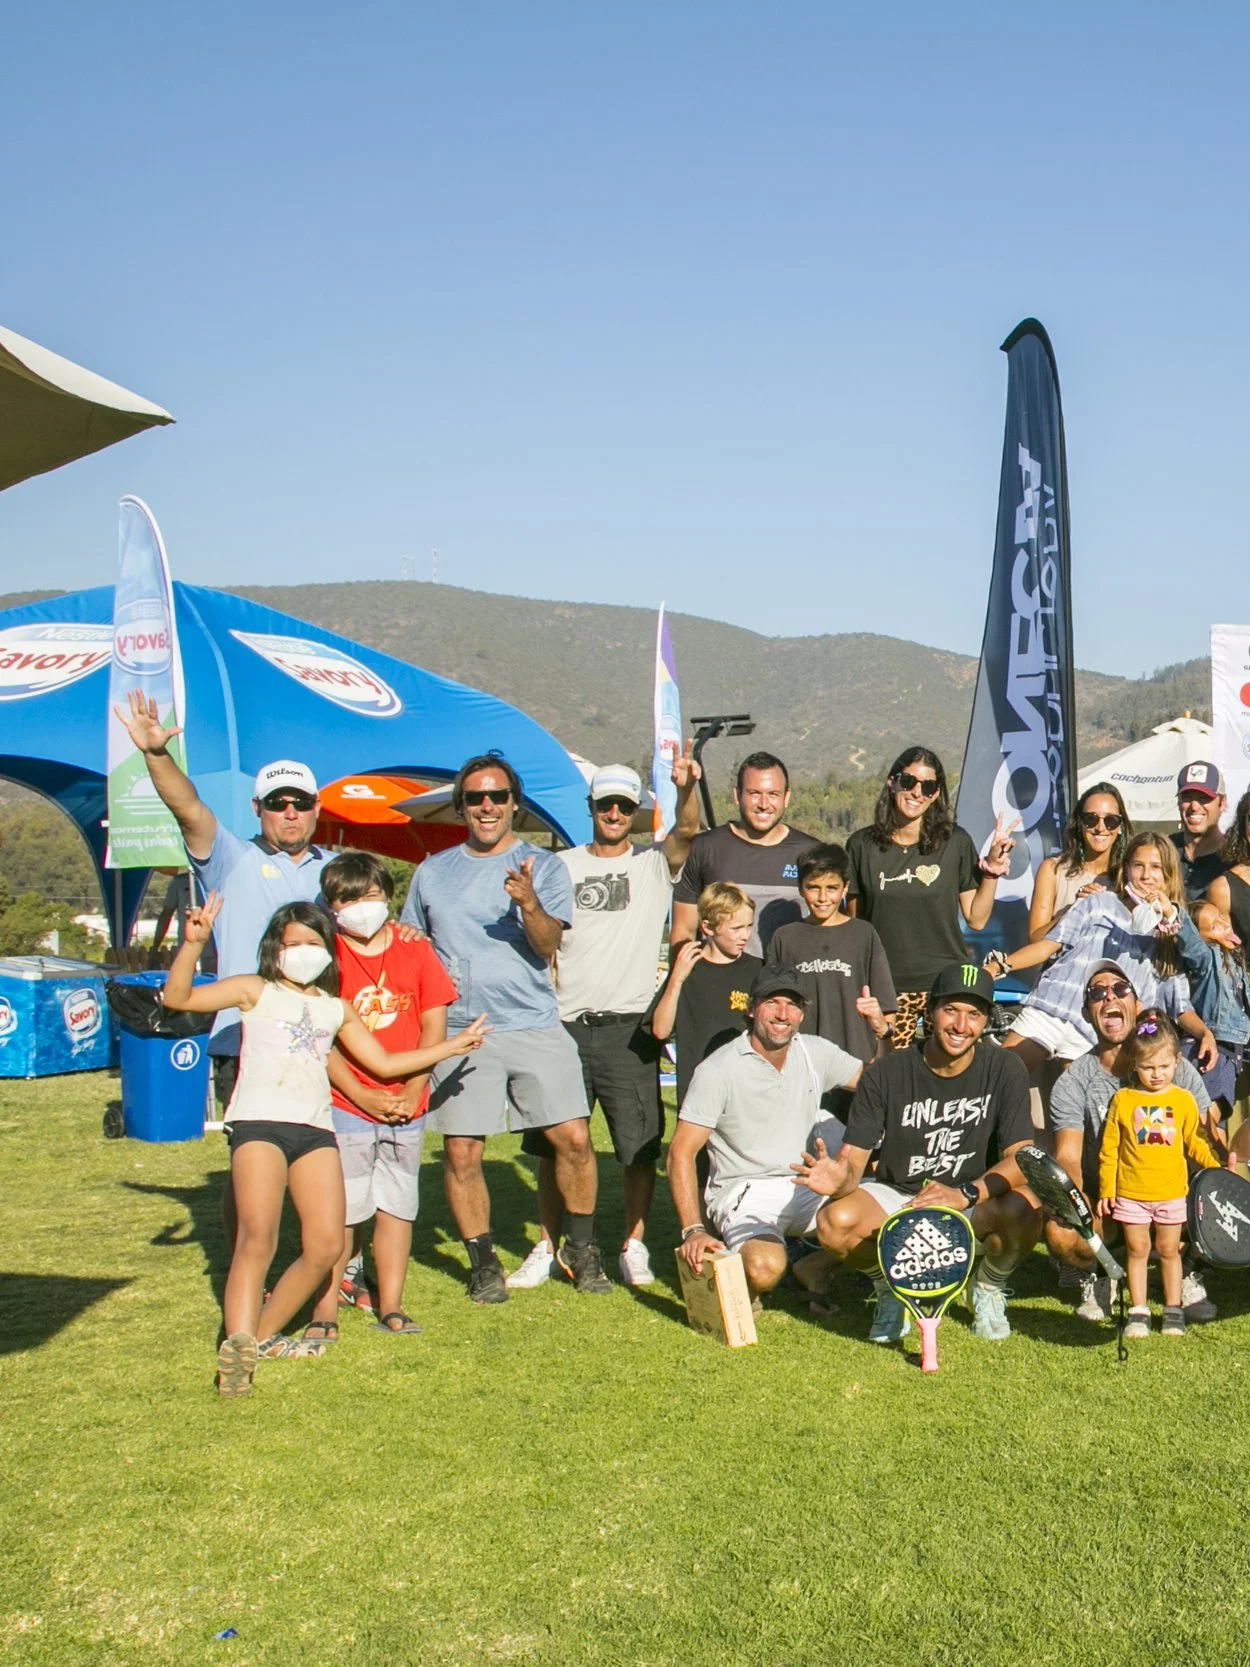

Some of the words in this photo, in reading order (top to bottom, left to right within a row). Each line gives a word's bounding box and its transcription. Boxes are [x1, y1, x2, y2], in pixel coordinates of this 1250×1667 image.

[266, 767, 304, 779] Wilson
[901, 1094, 991, 1129] UNLEASH
[924, 1127, 964, 1156] THE
[907, 1152, 976, 1178] BEST
[890, 1247, 968, 1280] adidas
